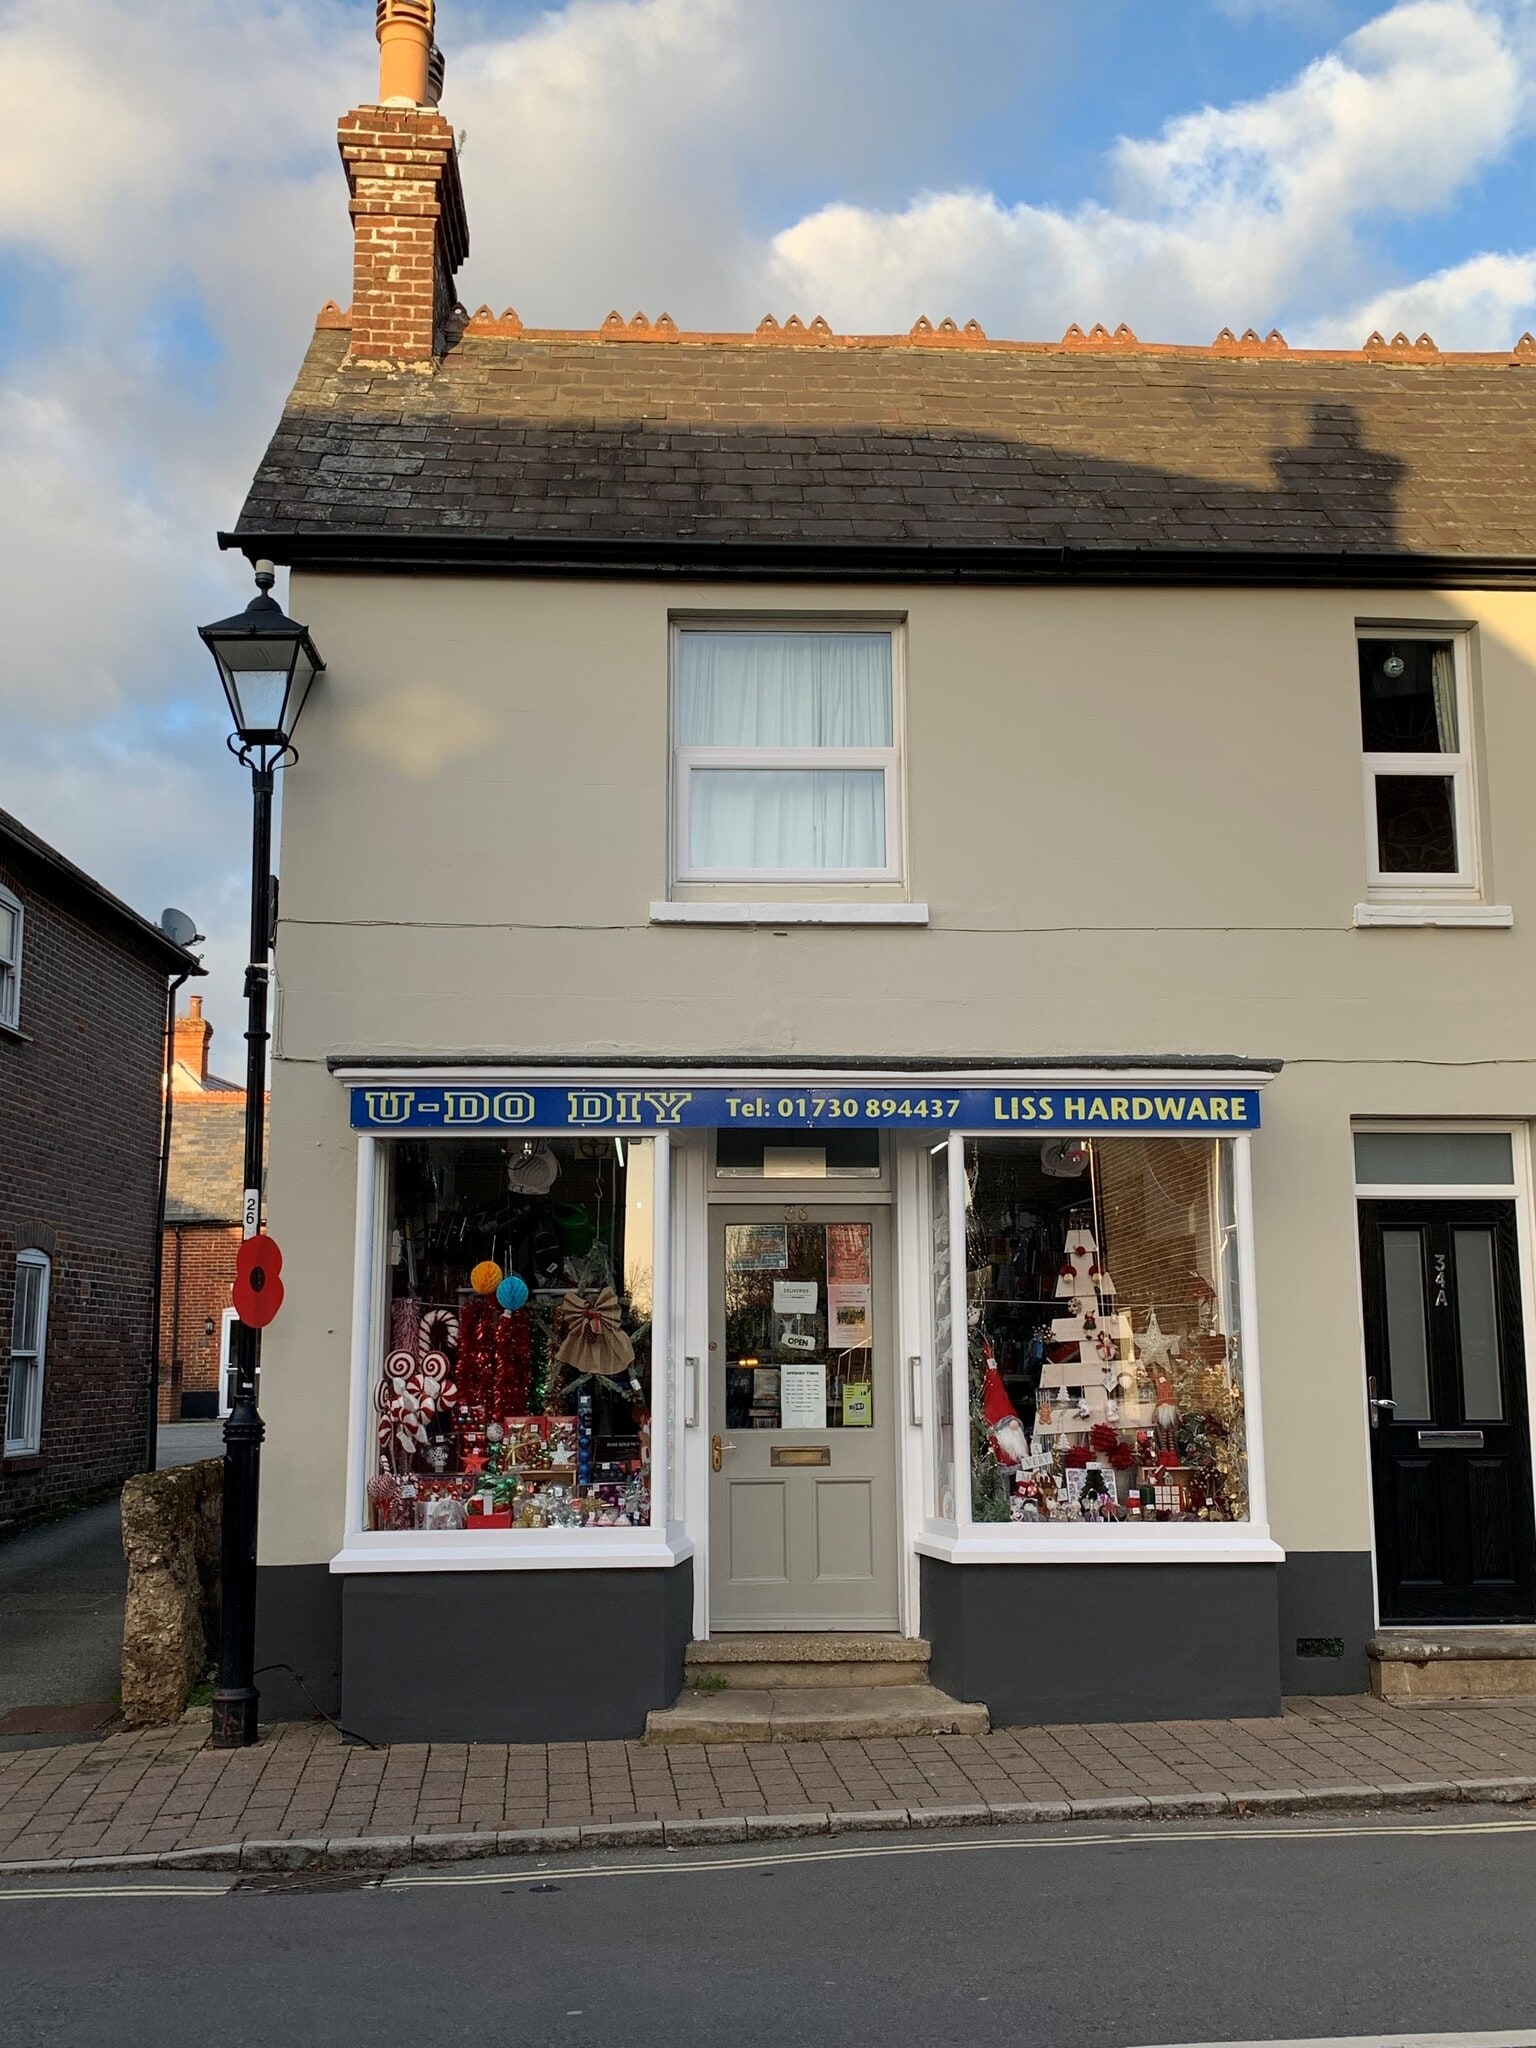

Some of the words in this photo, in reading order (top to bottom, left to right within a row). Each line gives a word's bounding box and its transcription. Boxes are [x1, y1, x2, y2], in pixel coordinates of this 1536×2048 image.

[365, 1091, 535, 1124] U-DO
[567, 1091, 692, 1124] DIY
[726, 1098, 771, 1118] Tel:
[777, 1098, 859, 1119] 01730
[865, 1099, 960, 1118] 894437
[994, 1096, 1054, 1120] LISS
[1064, 1097, 1247, 1121] HARDWARE
[787, 1337, 809, 1347] OPEN
[1024, 1454, 1050, 1466] VERY
